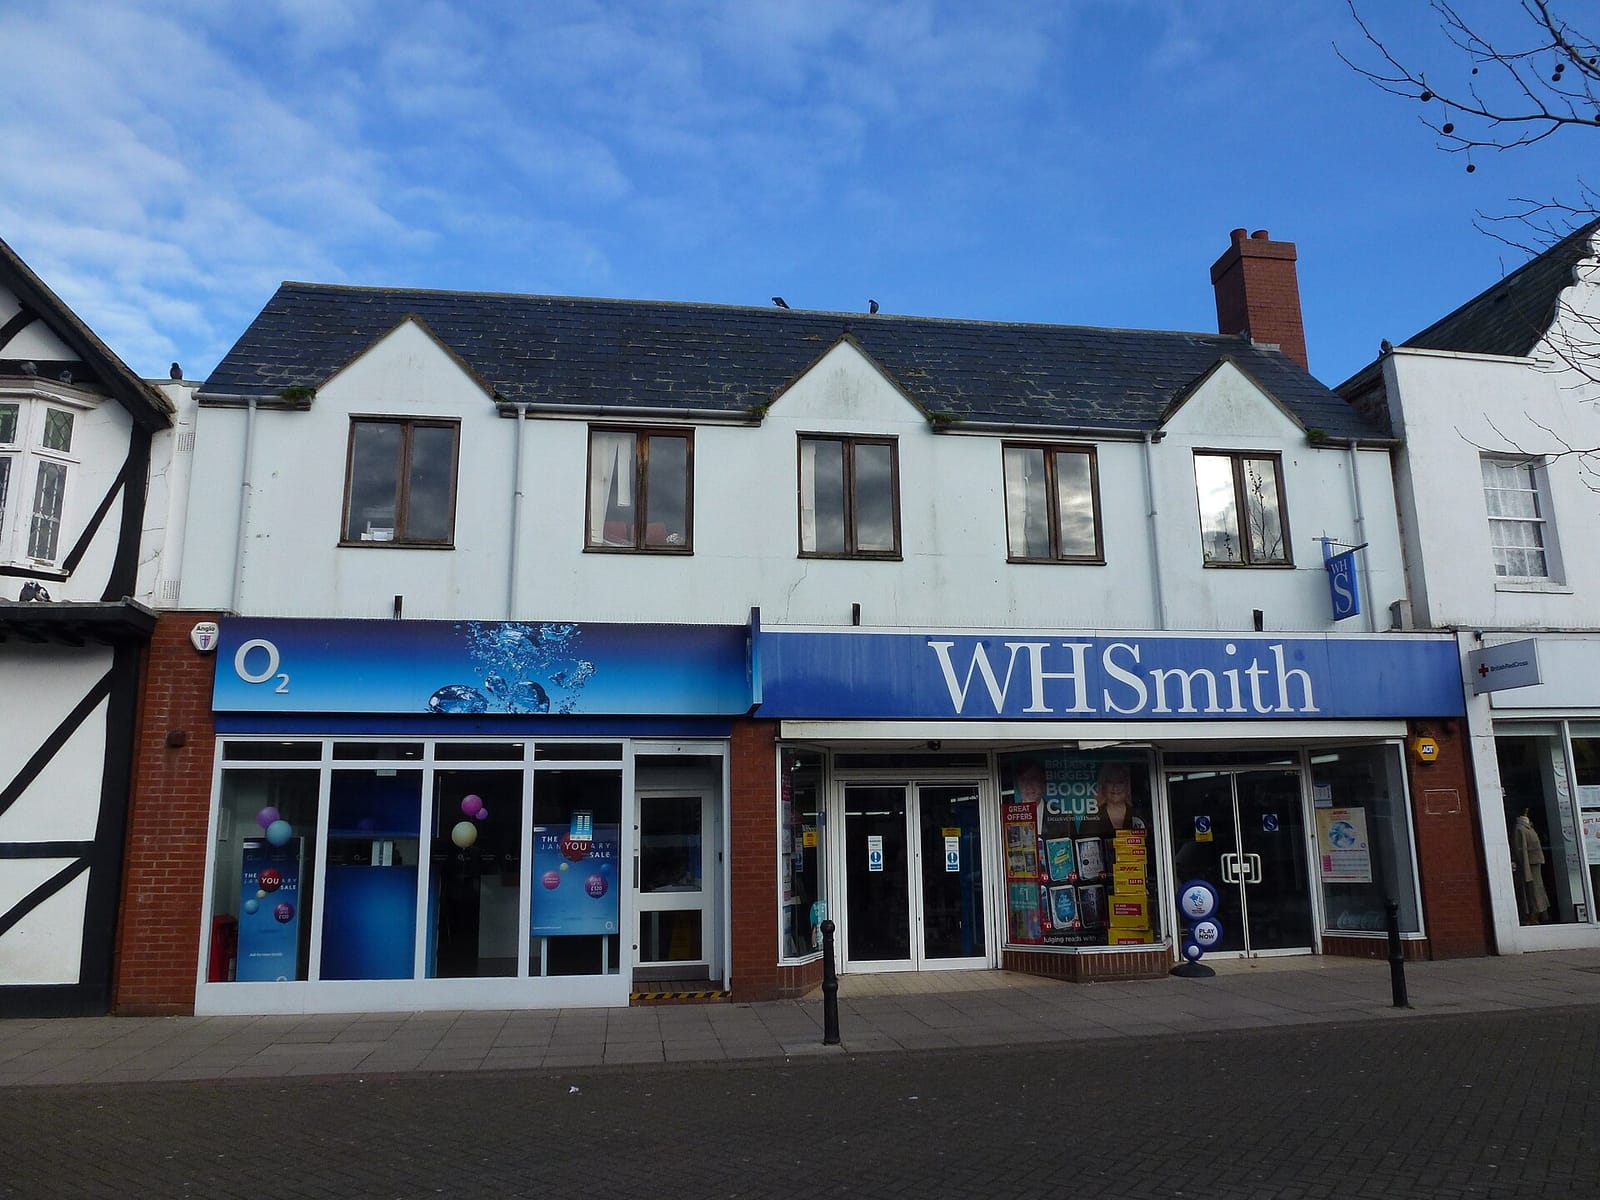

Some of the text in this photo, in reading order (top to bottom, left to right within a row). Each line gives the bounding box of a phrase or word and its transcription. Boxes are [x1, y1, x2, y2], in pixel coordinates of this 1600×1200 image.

[1330, 558, 1348, 574] WH
[1333, 573, 1351, 614] S
[927, 641, 1320, 714] WHSmith
[1045, 770, 1097, 780] BIGGEST
[1046, 782, 1098, 796] BOOK
[1008, 804, 1030, 813] GREAT
[1046, 798, 1099, 815] CLUB
[1007, 812, 1033, 821] OFFERS
[564, 841, 587, 851] YOU
[261, 877, 280, 885] YOU
